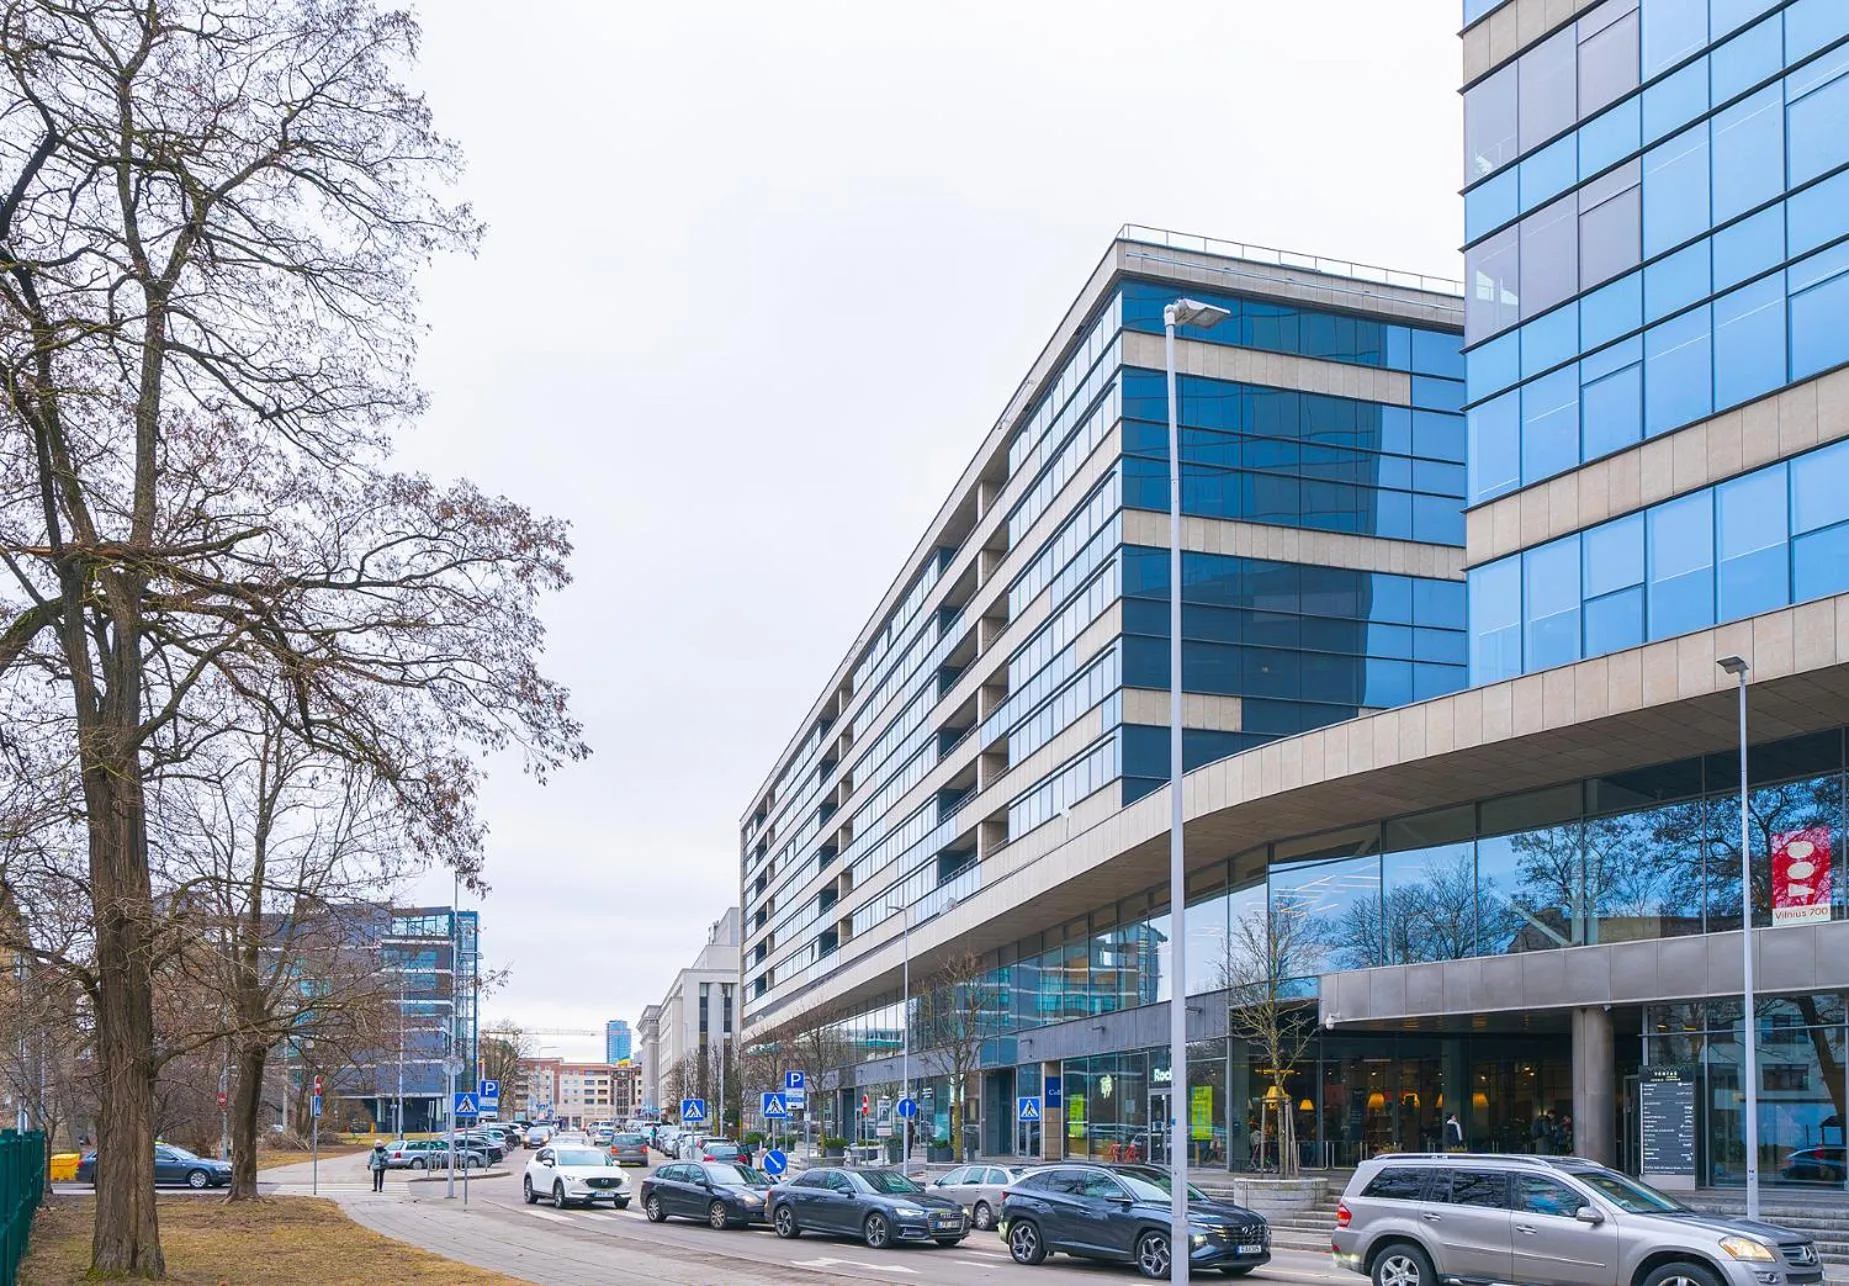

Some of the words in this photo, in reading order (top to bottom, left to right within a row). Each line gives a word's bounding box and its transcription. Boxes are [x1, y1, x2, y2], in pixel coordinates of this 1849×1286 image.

[1775, 910, 1806, 920] Vilnius
[1809, 907, 1829, 917] 700
[790, 1073, 801, 1087] P
[485, 1082, 496, 1096] P
